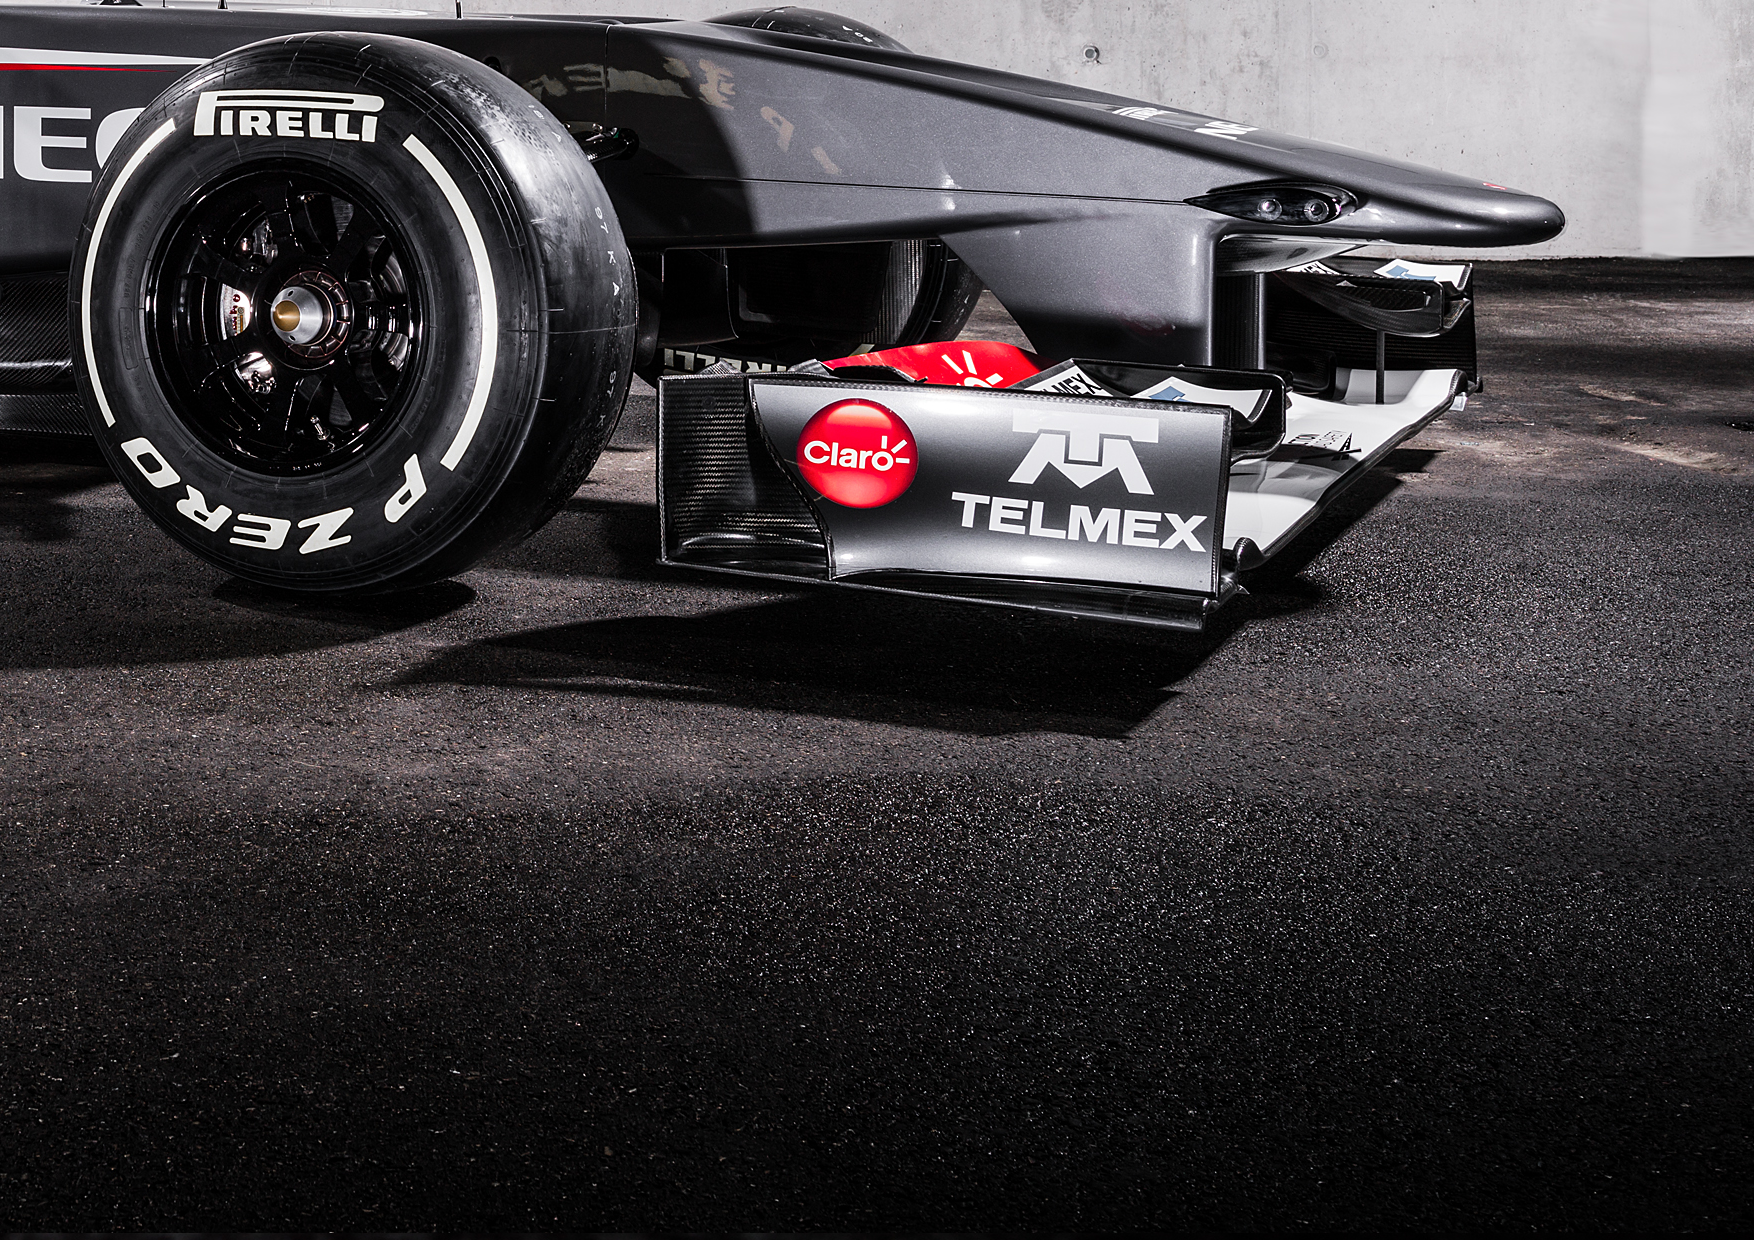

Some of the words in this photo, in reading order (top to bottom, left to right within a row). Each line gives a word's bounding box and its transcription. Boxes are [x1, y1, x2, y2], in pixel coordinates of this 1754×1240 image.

[193, 89, 385, 143] PIRELLI
[804, 441, 894, 472] Claro
[120, 436, 354, 555] ZERO
[384, 452, 427, 524] P
[951, 491, 1208, 553] TELMEX
